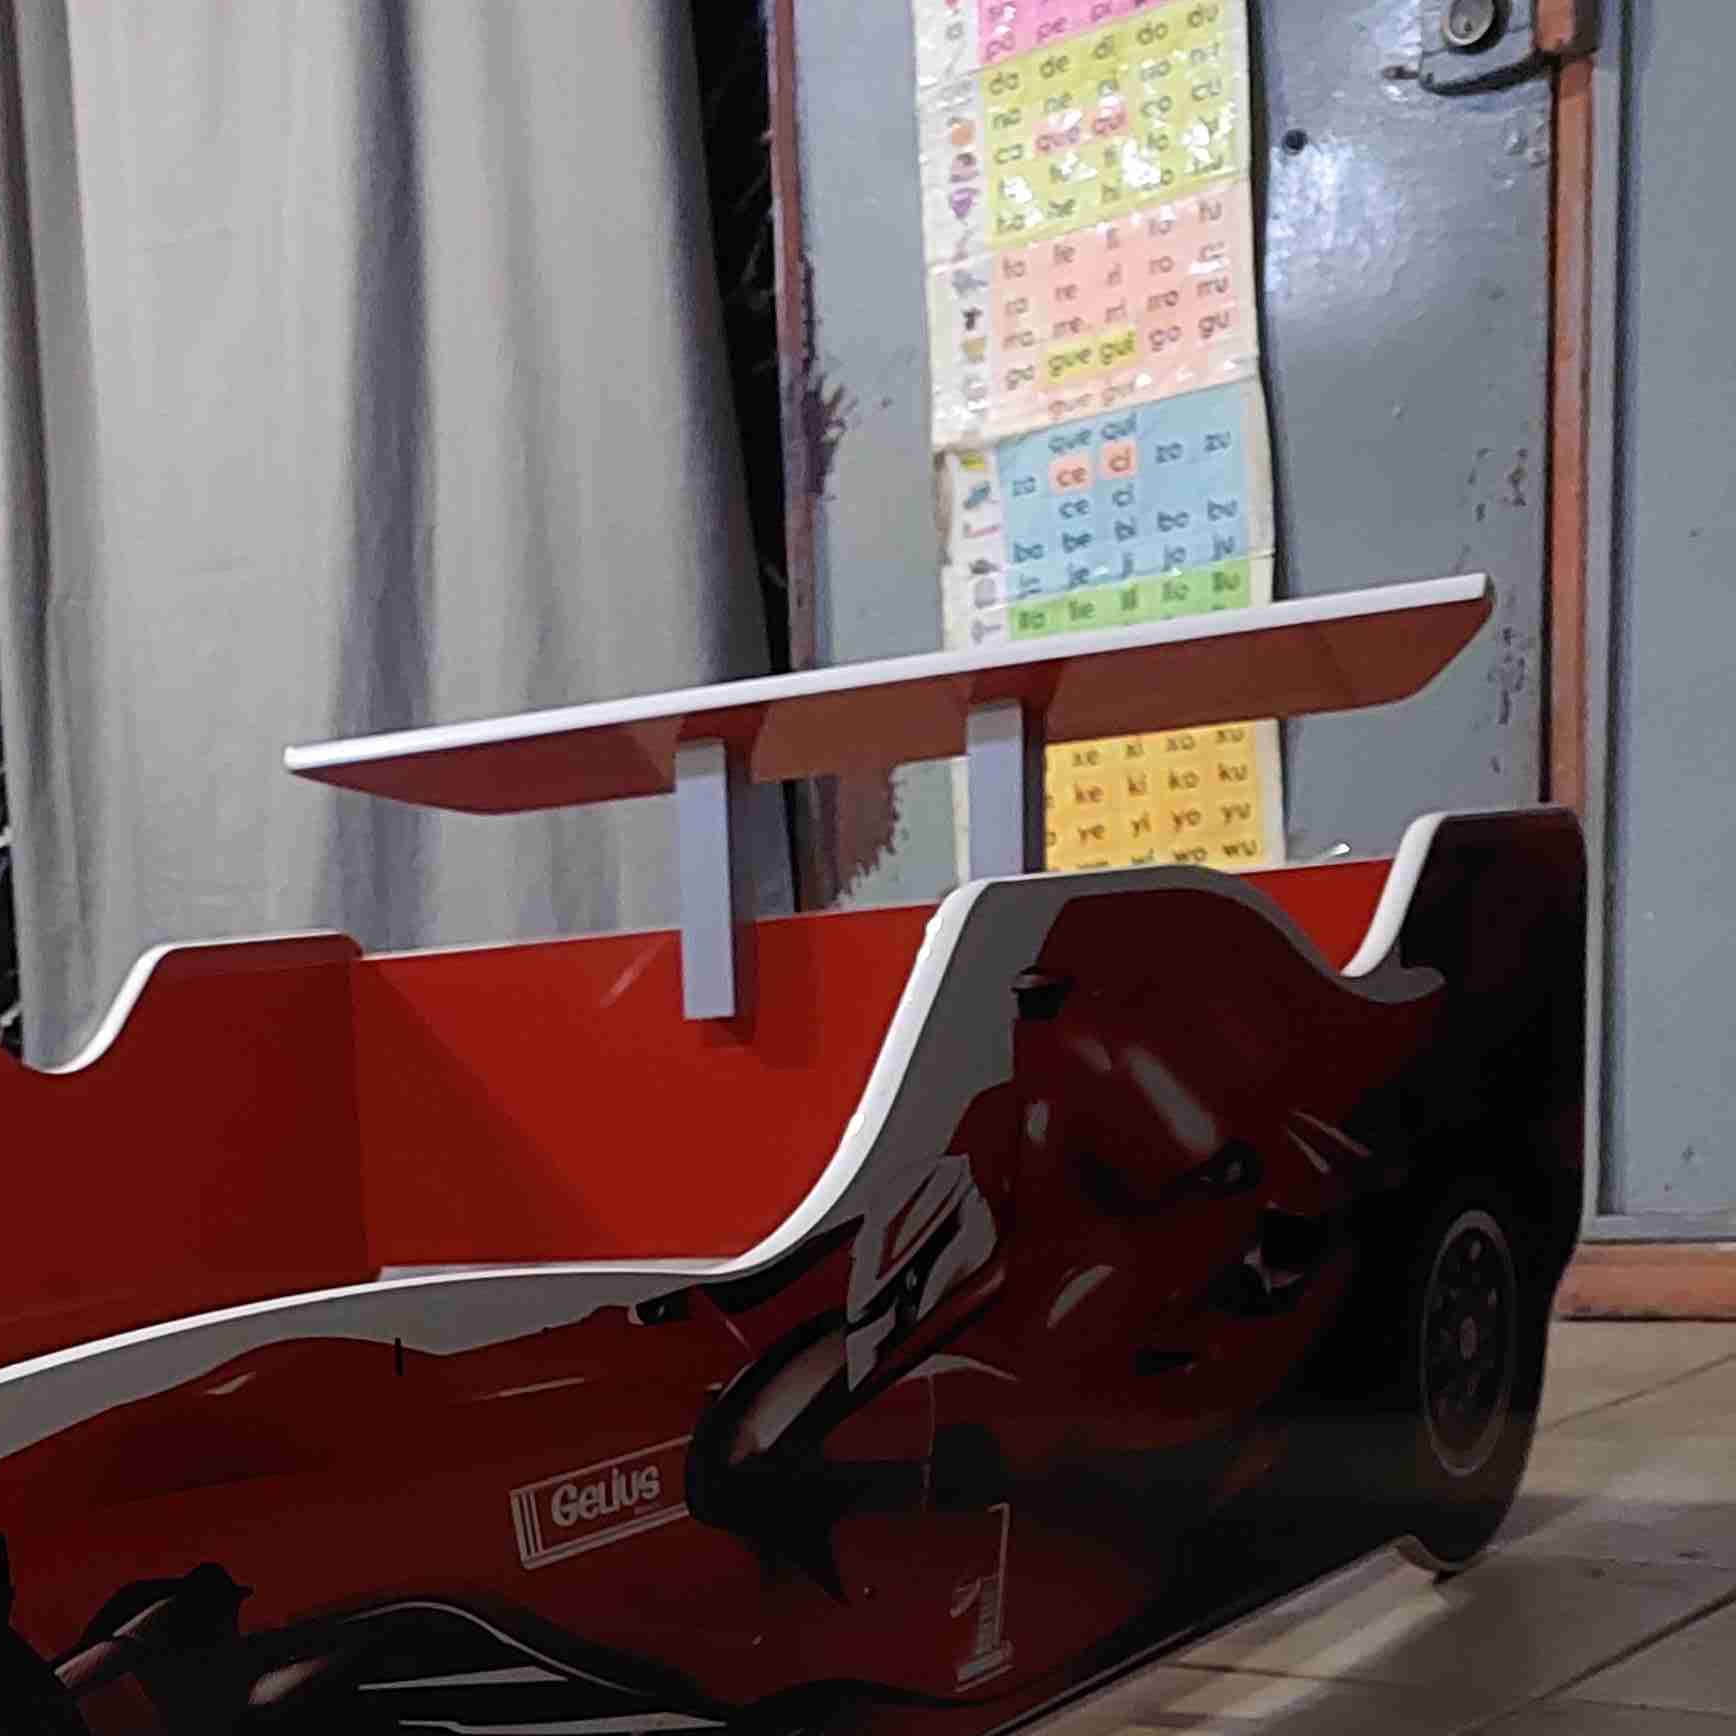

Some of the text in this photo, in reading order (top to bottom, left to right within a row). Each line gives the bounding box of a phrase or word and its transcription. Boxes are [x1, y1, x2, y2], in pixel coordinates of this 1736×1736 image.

[989, 71, 1020, 95] da
[1039, 54, 1071, 79] de
[1136, 20, 1169, 45] do
[1055, 466, 1088, 488] ce
[1058, 498, 1089, 519] ce
[1073, 783, 1104, 803] ke
[1127, 772, 1148, 795] ki
[1168, 770, 1200, 790] ko
[1217, 762, 1249, 782] ku
[1078, 823, 1105, 846] ye
[1130, 810, 1151, 838] yi
[1171, 808, 1202, 833] yo
[1221, 801, 1251, 825] yu
[1173, 846, 1207, 863] wo
[1222, 839, 1258, 858] wu
